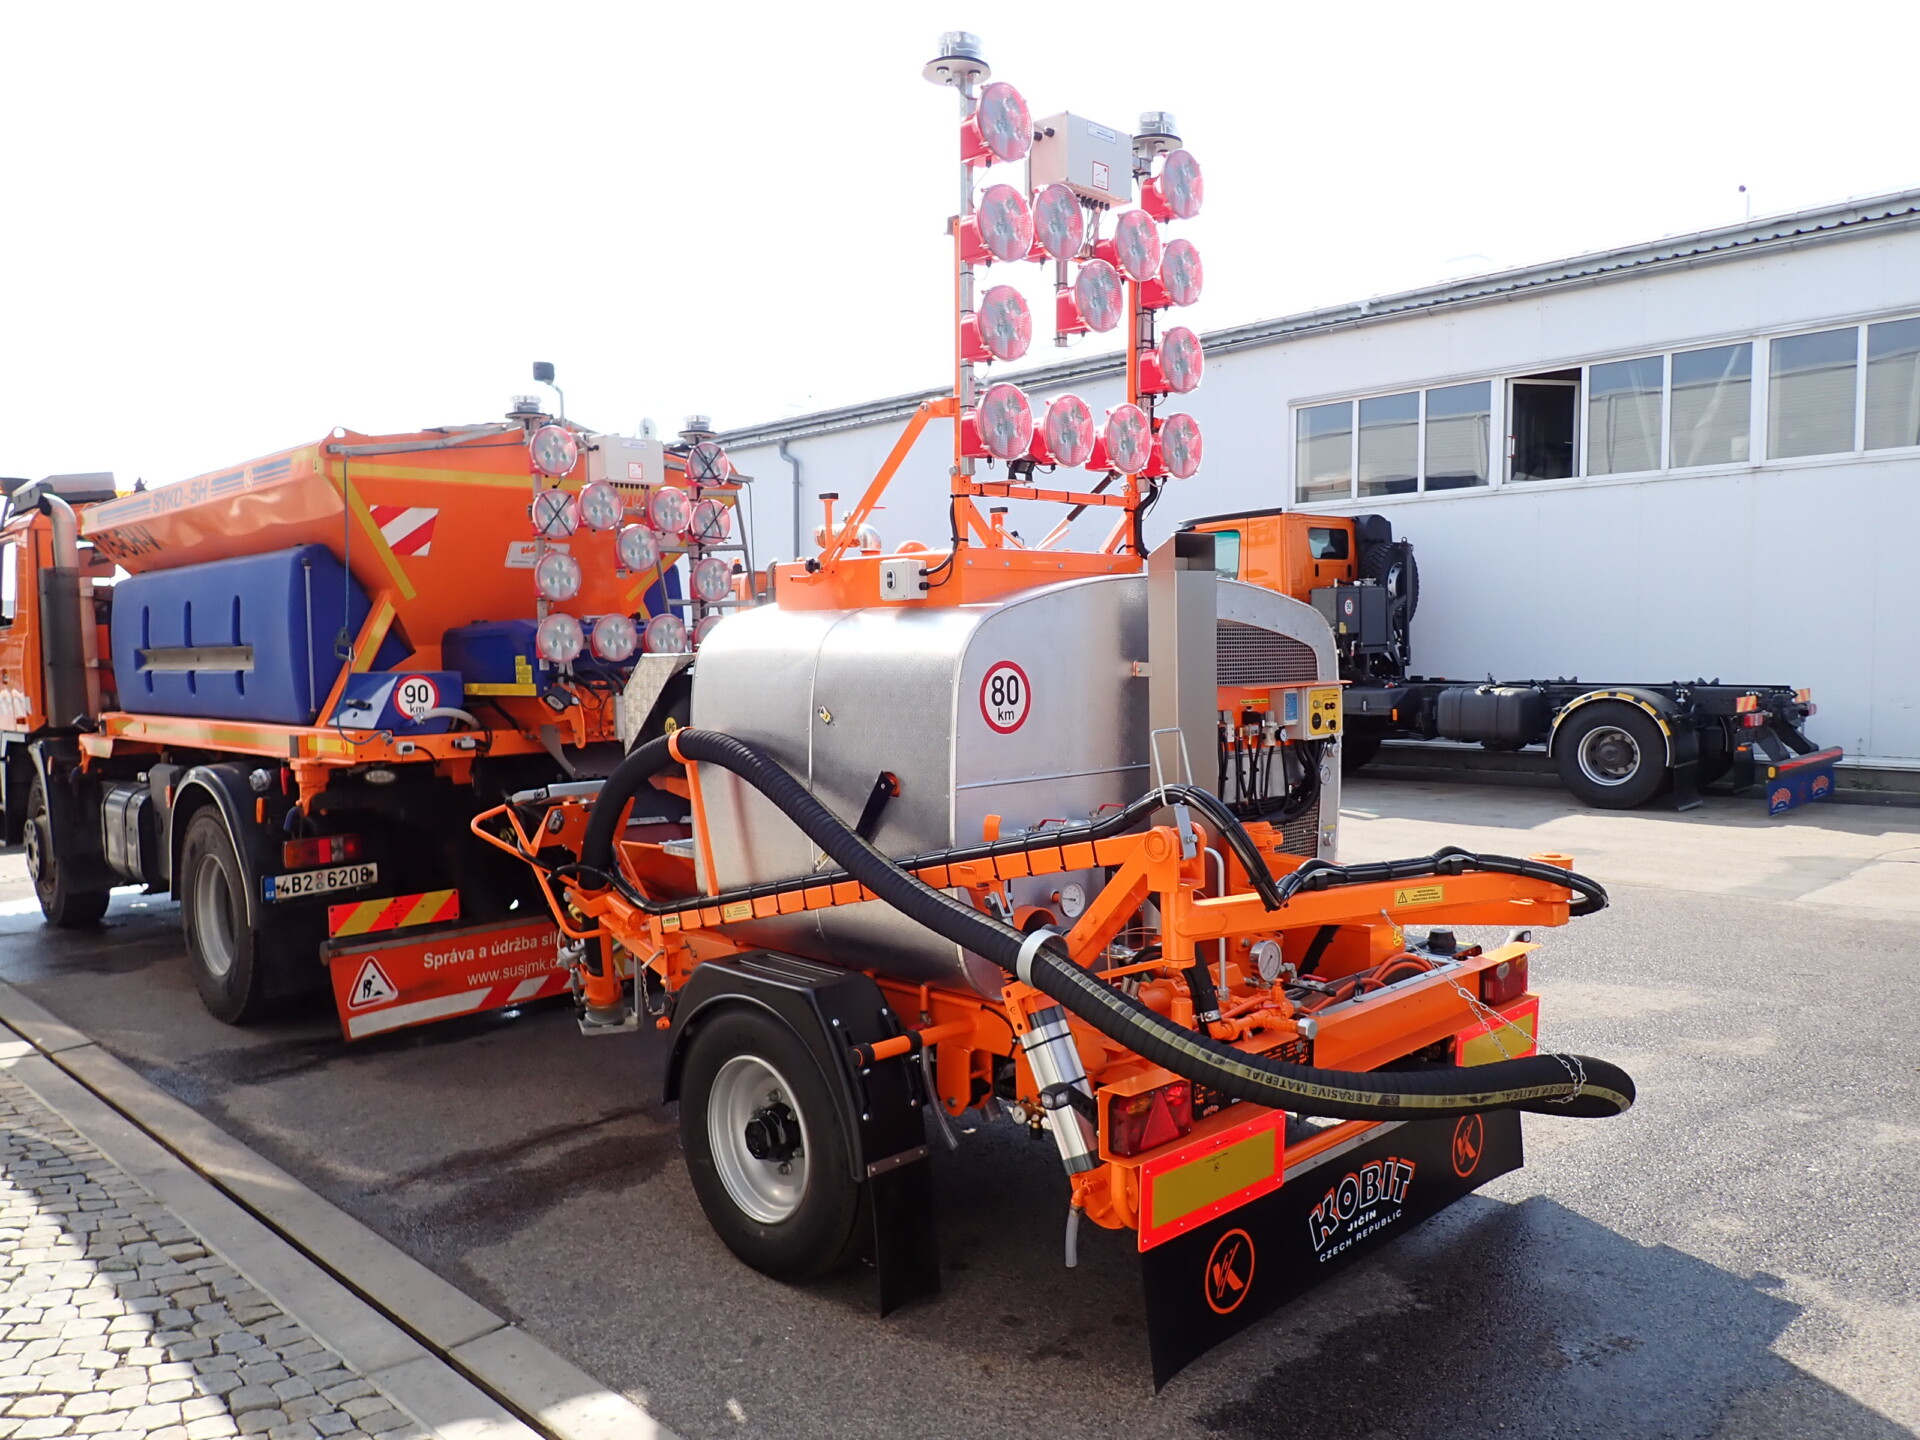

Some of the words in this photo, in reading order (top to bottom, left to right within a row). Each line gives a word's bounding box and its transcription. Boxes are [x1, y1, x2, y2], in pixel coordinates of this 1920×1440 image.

[404, 684, 429, 704] 90
[991, 675, 1019, 706] 80
[409, 704, 425, 713] km
[998, 707, 1015, 721] km
[281, 876, 313, 895] 4B2
[327, 867, 370, 888] 6208
[423, 948, 475, 970] Správa
[478, 946, 488, 958] a
[491, 936, 538, 956] údržba
[467, 957, 560, 986] www.susjmk.c
[1246, 1067, 1308, 1093] MATERIAL
[1311, 1086, 1373, 1103] ABRASIVE
[1308, 1157, 1416, 1251] KOBIT
[1347, 1209, 1377, 1232] JIČÍN
[1319, 1238, 1352, 1262] CZECH
[1356, 1209, 1402, 1241] REPUBLIC
